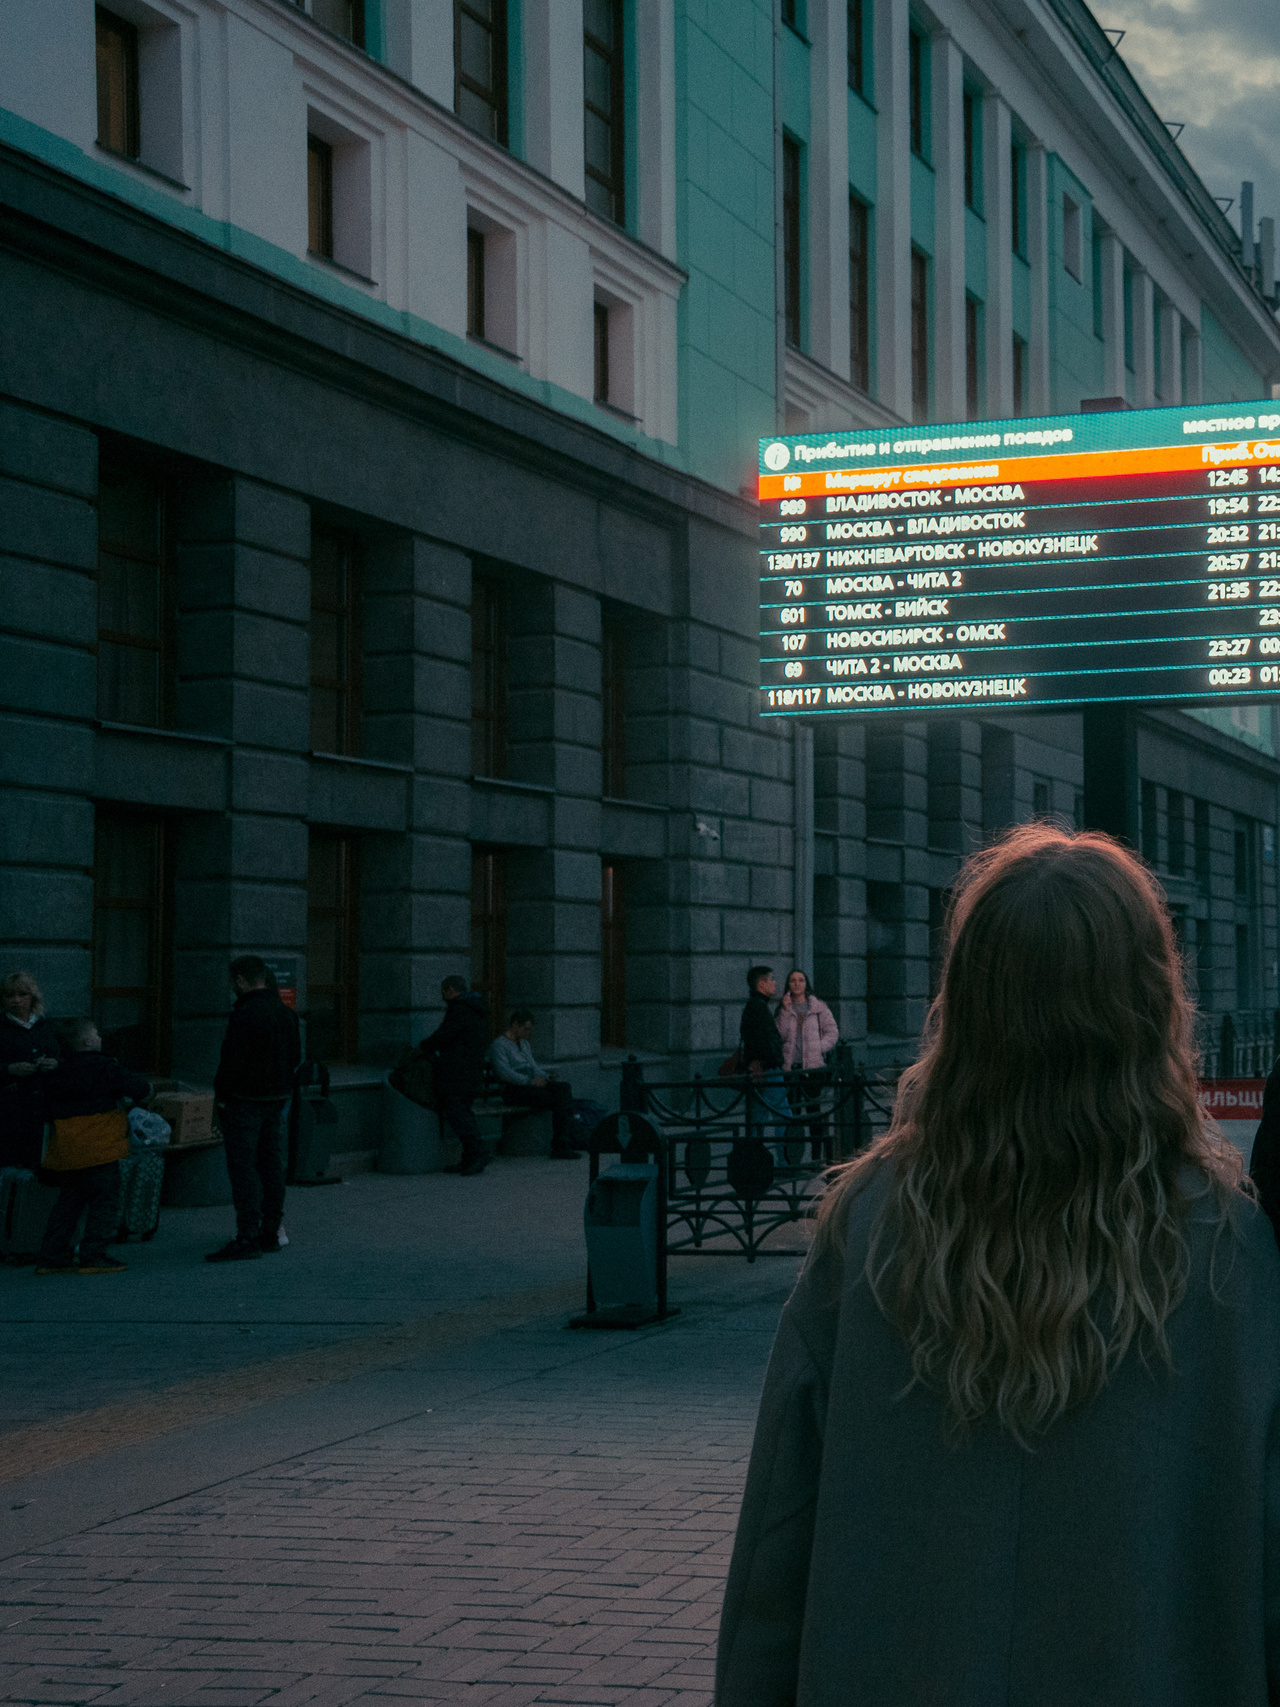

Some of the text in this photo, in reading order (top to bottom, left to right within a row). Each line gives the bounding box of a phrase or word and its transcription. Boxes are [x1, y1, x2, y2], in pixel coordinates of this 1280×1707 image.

[1182, 415, 1256, 435] местное
[794, 428, 1074, 464] Прибытие и отправление поездов
[780, 498, 807, 517] 989
[826, 489, 942, 513] ВЛАДИВОСТОК
[955, 484, 1025, 505] МОСКВА
[1207, 468, 1249, 487] 12:45
[825, 471, 902, 491] Маршрут
[902, 464, 999, 485] следования
[780, 525, 807, 543] 990
[826, 520, 894, 540] МОСКВА
[907, 511, 1026, 535] ВЛАДИВОСТОК
[1207, 496, 1250, 515] 19:54
[767, 551, 821, 571] 138/137
[826, 542, 966, 567] НИЖНЕВАРТОВСК
[978, 534, 1100, 558] НОВОКУЗНЕЦК
[1207, 525, 1249, 544] 20:32
[784, 580, 803, 597] 70
[826, 574, 895, 595] МОСКВА
[906, 571, 950, 589] ЧИТА
[951, 570, 962, 587] 2
[1207, 553, 1250, 572] 20:57
[780, 606, 806, 624] 601
[825, 602, 883, 622] ТОМСК
[895, 597, 950, 618] БИЙСК
[1207, 581, 1250, 600] 21:35
[781, 633, 807, 651] 107
[826, 626, 944, 649] НОВОСИБИРСК
[956, 623, 1006, 642] ОМСК
[784, 661, 803, 679] 69
[826, 658, 868, 676] ЧИТА
[869, 657, 881, 674] 2
[893, 653, 963, 673] МОСКВА
[1207, 638, 1251, 657] 23:27
[768, 687, 822, 707] 118/117
[826, 684, 896, 704] МОСКВА
[908, 677, 1028, 701] НОВОКУЗНЕЦК
[1208, 667, 1251, 686] 00:23
